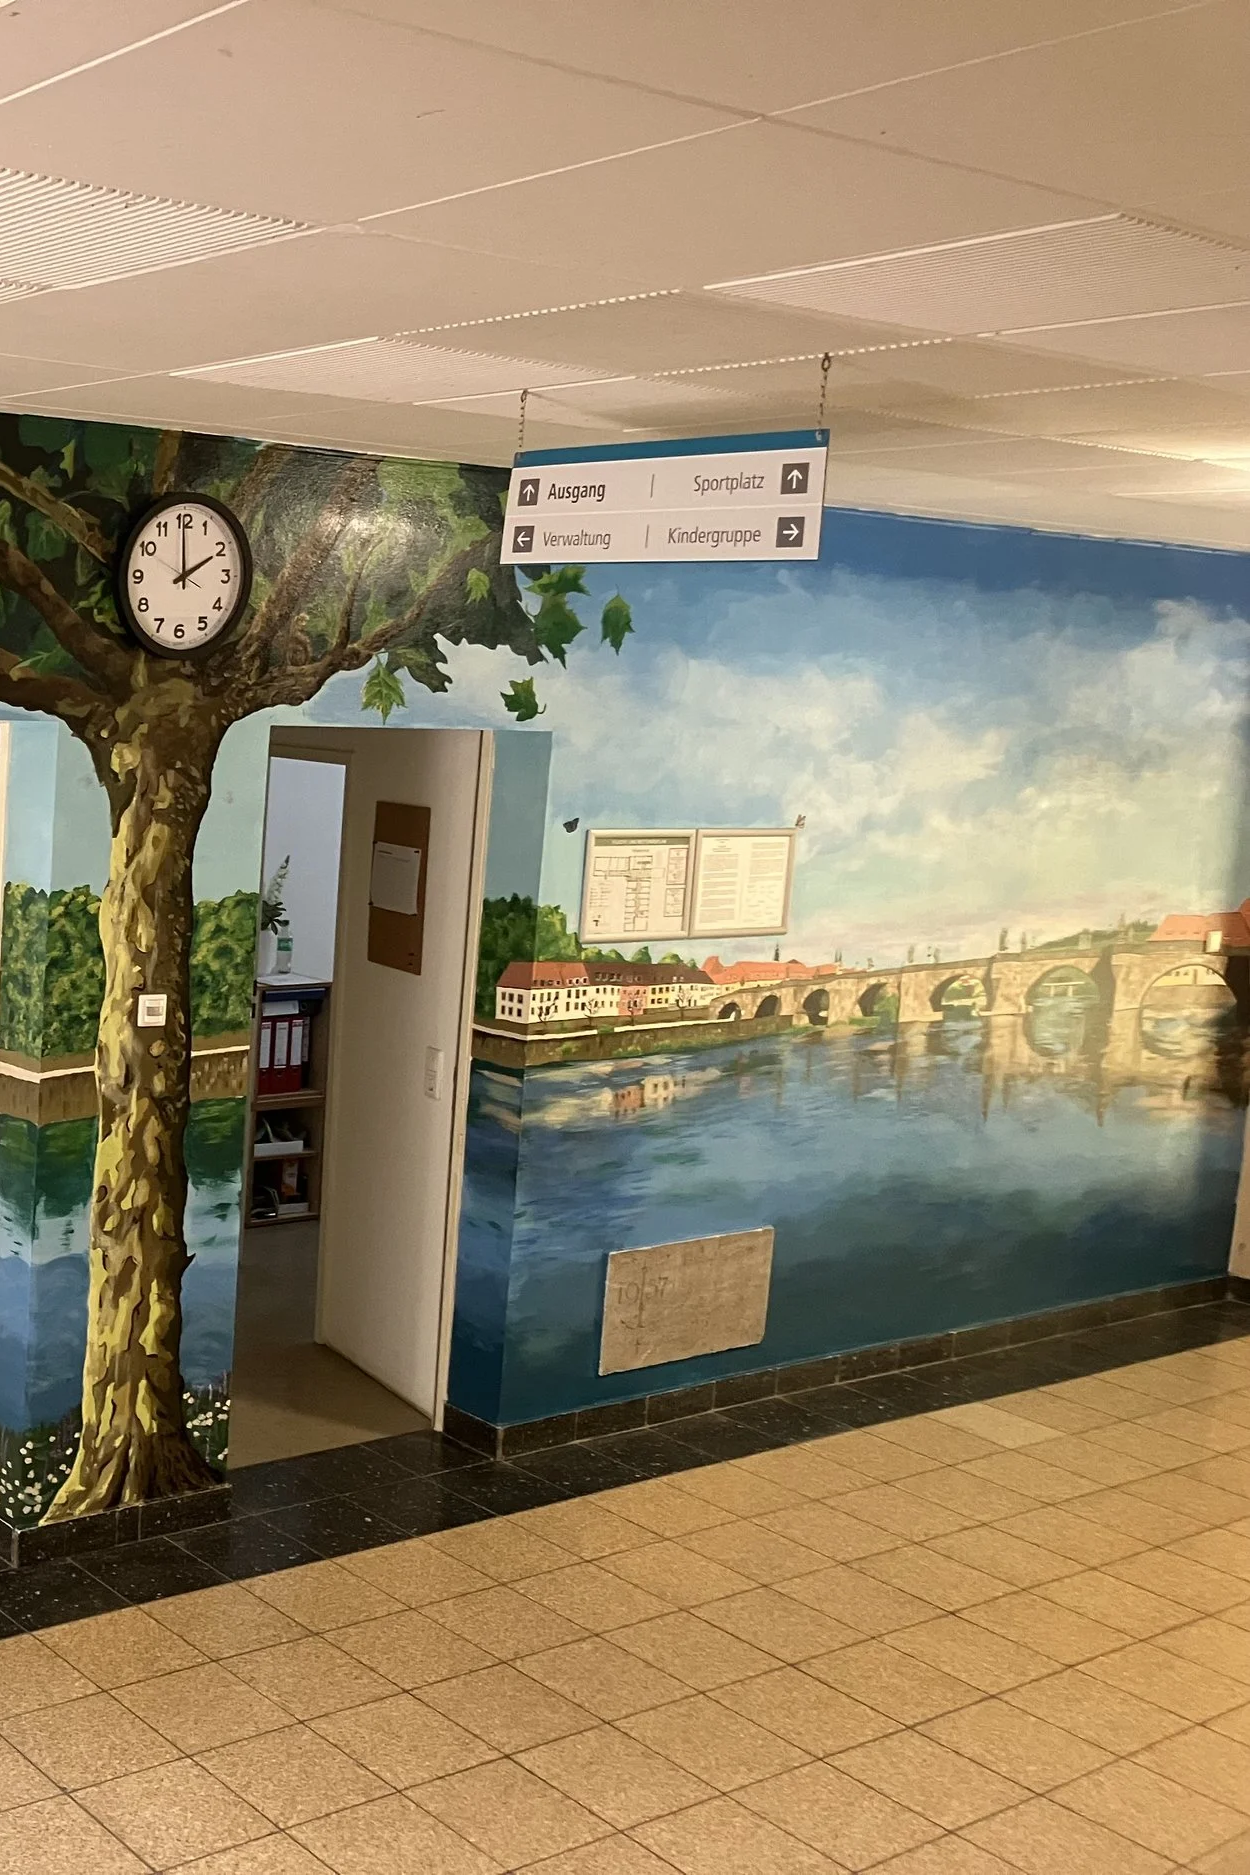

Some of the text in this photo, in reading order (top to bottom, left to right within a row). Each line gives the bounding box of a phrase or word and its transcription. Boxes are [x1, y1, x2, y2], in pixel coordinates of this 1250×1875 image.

[693, 472, 764, 496] Sportplatz
[547, 482, 606, 503] Ausgang
[176, 513, 193, 529] 12
[202, 520, 208, 536] 1
[156, 521, 168, 537] 11
[668, 525, 761, 548] Kindergruppe
[543, 529, 611, 549] Verwaltung
[139, 540, 157, 556] 10
[215, 542, 226, 557] 2
[132, 569, 144, 584] 9
[221, 569, 231, 584] 3
[137, 597, 149, 612] 8
[212, 597, 223, 611] 4
[154, 618, 165, 633] 7
[174, 624, 185, 638] 6
[197, 616, 208, 631] 5
